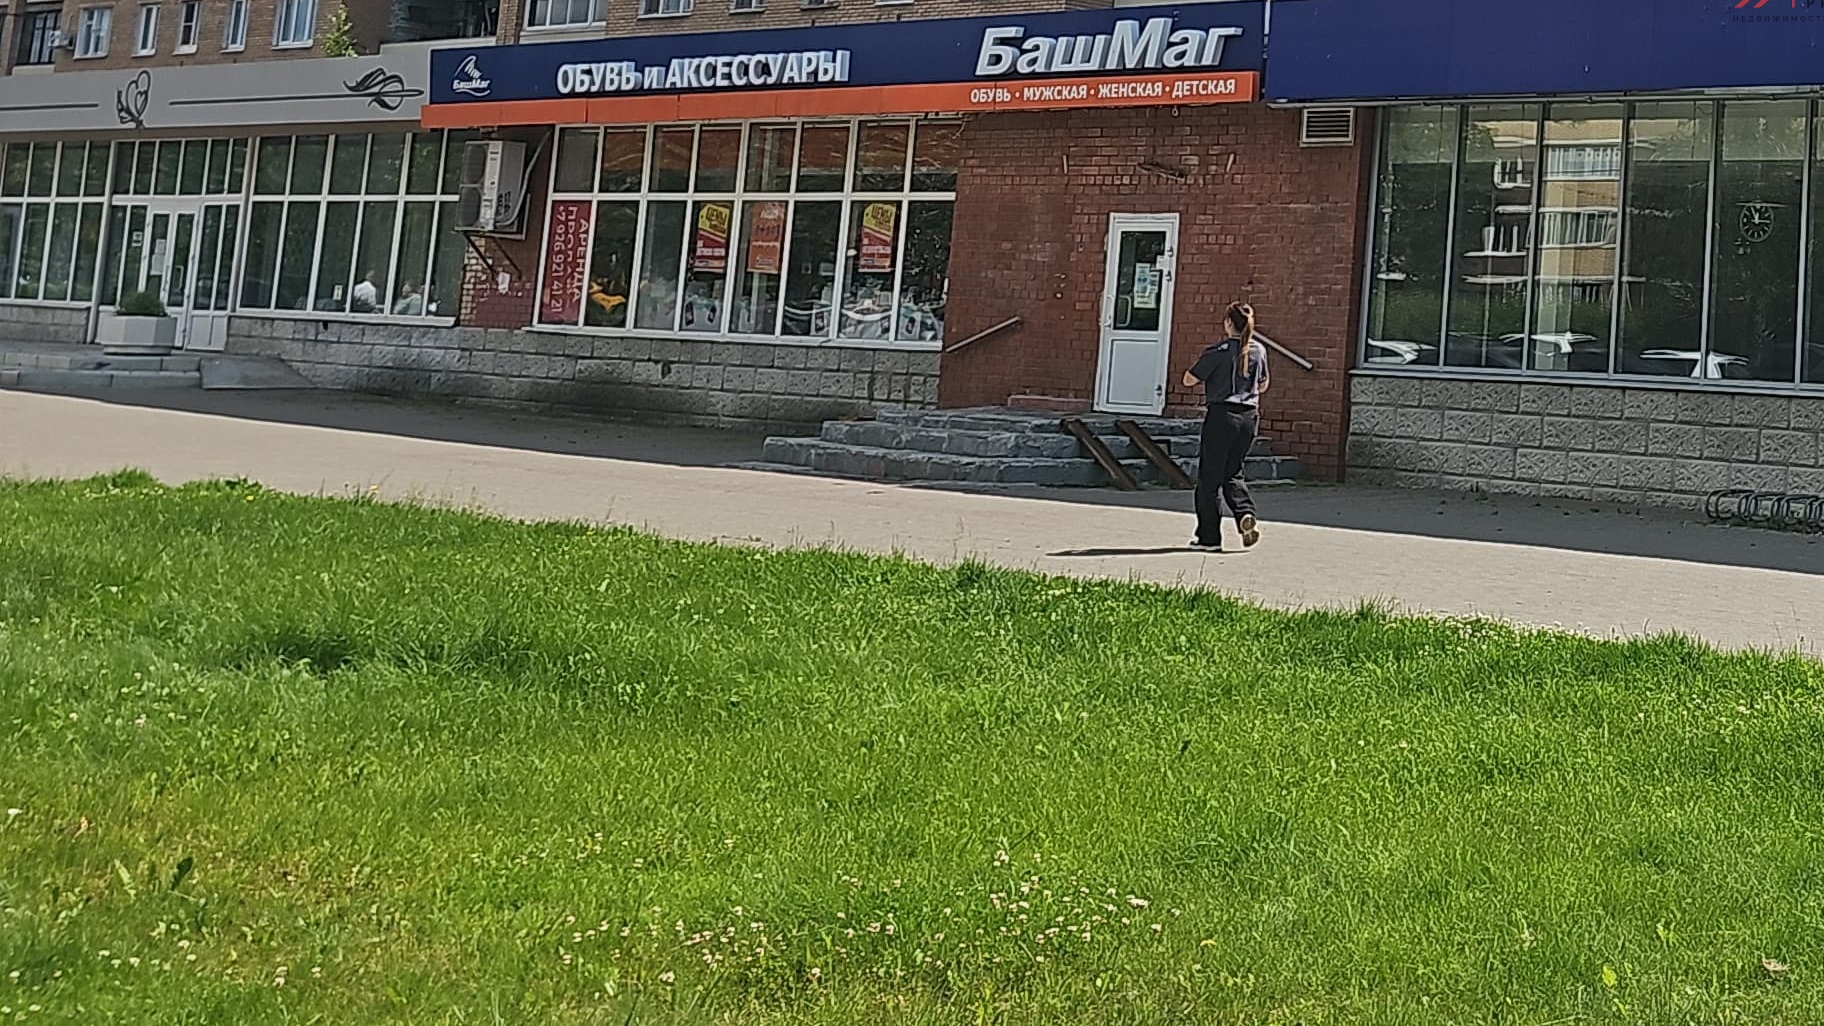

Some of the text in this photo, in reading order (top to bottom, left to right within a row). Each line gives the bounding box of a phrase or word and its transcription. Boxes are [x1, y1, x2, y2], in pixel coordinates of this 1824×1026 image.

[975, 17, 1243, 75] БашМаг
[557, 49, 850, 94] ОБУВЬ и АКСЕССУАРЫ
[970, 79, 1235, 103] ОБУВЬ МУЖСКАЯ ЖЕНСКАЯ ДЕТСКАЯ
[553, 224, 565, 252] 926
[552, 254, 564, 277] 921
[572, 218, 589, 304] АРЕНДА
[552, 281, 563, 295] 41
[551, 299, 563, 312] 21
